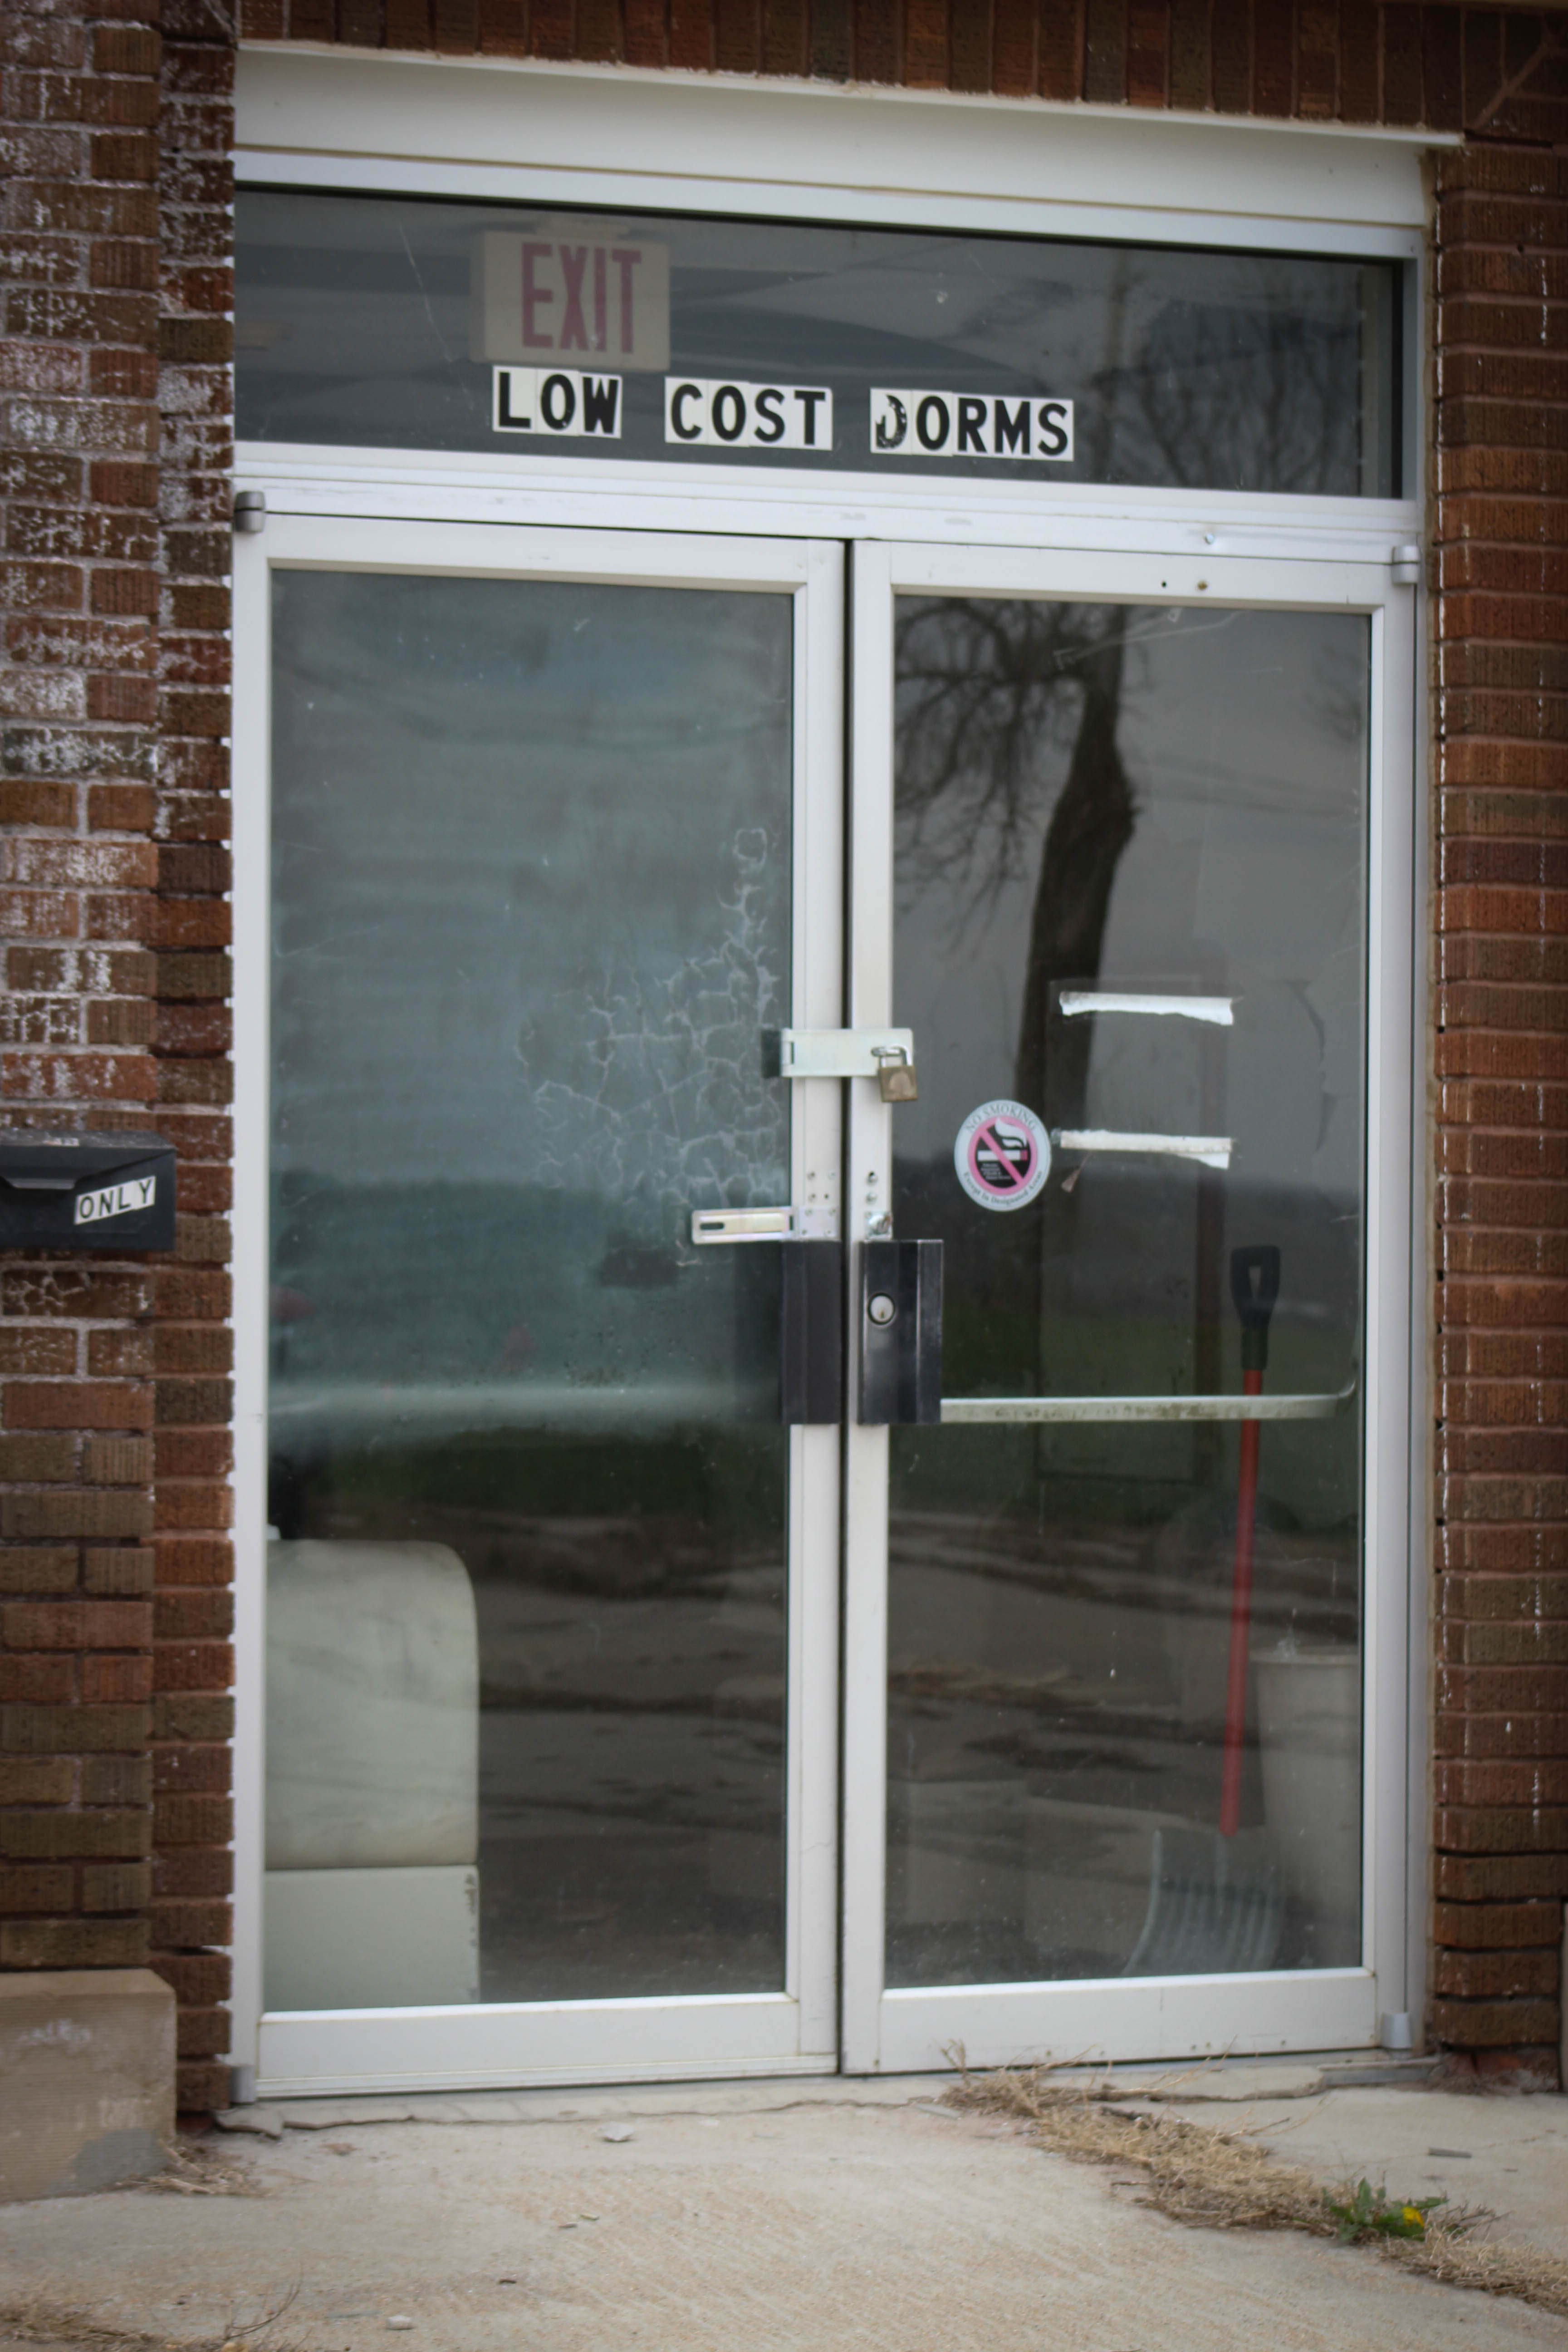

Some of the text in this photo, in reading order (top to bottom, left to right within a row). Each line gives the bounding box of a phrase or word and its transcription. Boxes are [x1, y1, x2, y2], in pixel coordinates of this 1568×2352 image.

[522, 242, 642, 354] EXIT
[499, 372, 1068, 457] LOW COST DORMS
[965, 1103, 1036, 1133] NO SMOKING
[79, 1180, 152, 1219] ONLY
[990, 1188, 1029, 1207] Designated
